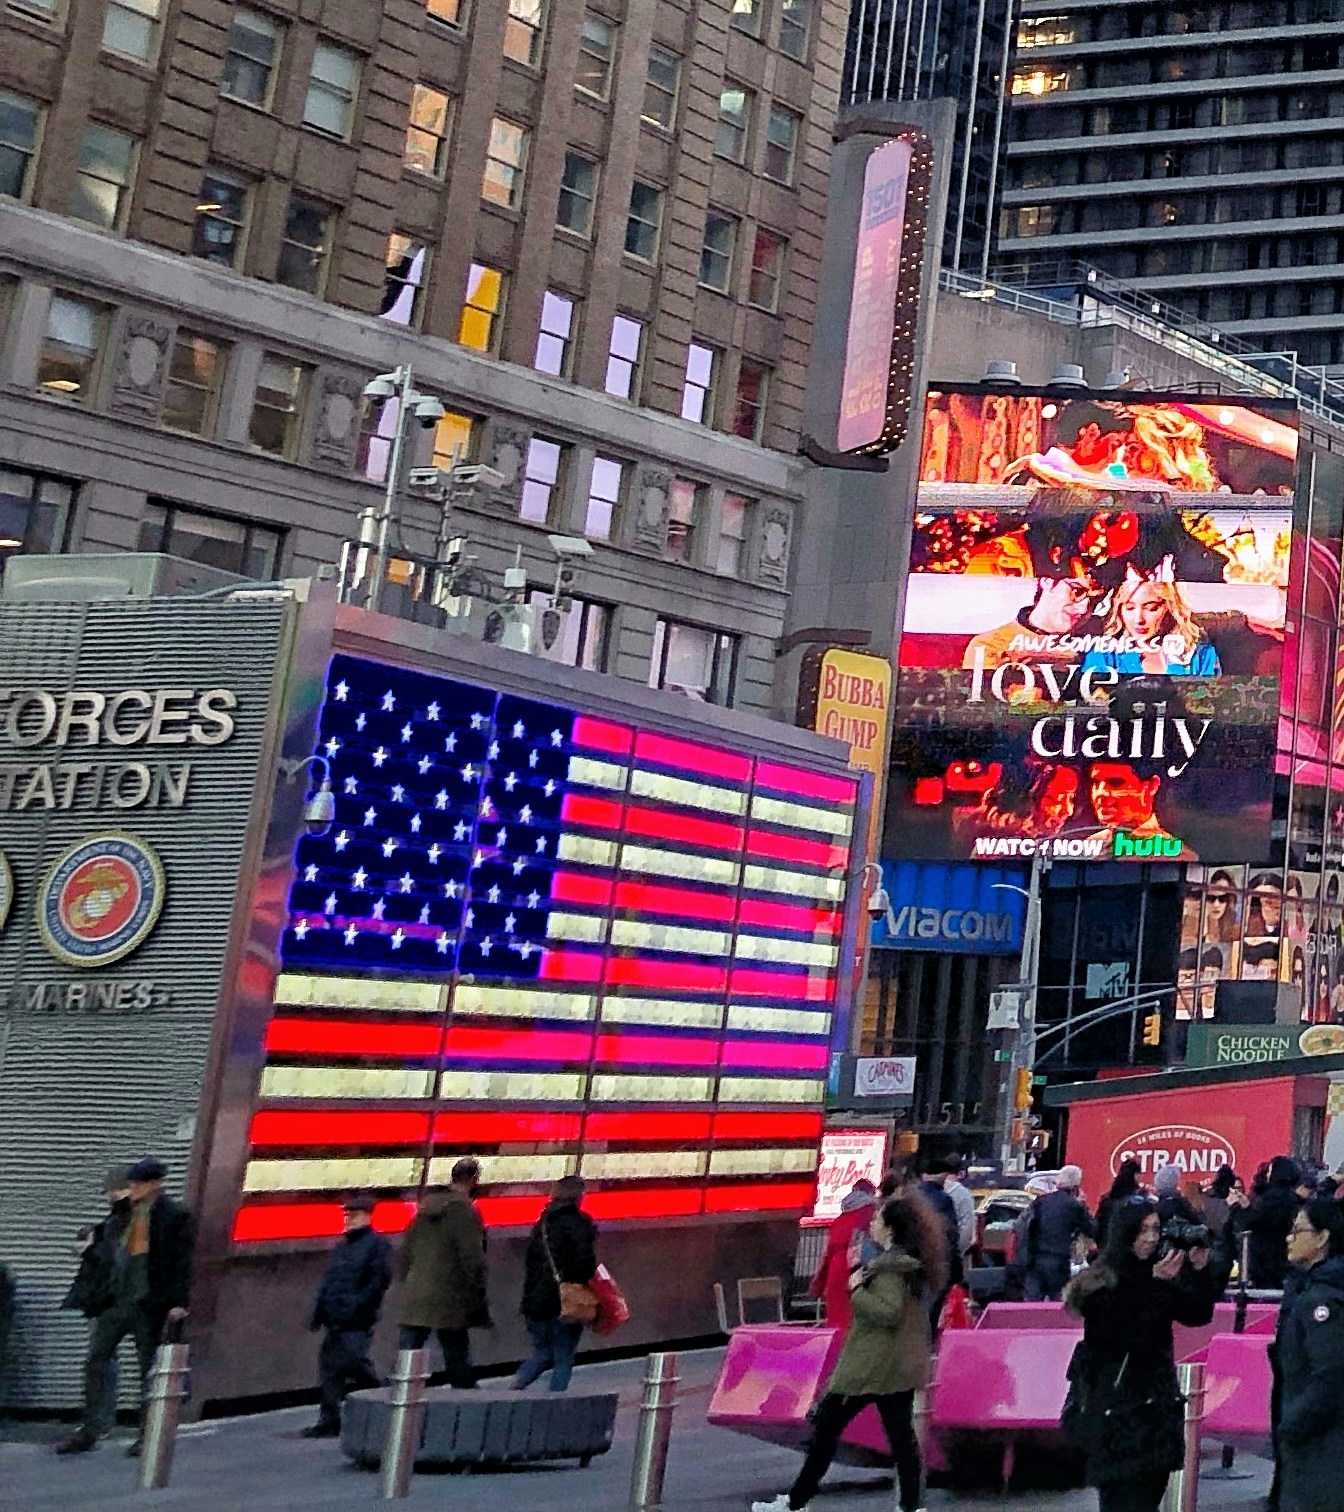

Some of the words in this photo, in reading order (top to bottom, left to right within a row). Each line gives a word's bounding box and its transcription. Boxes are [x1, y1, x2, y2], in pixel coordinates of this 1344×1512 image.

[823, 664, 885, 709] BUBBA
[966, 645, 1119, 707] love
[3, 688, 238, 746] ORCES
[825, 709, 878, 750] GUMP
[1031, 700, 1213, 777] daily
[0, 762, 192, 810] TATION
[1053, 838, 1103, 856] NOW
[1114, 830, 1182, 857] hulu
[26, 983, 154, 1010] MARINES
[1217, 1035, 1290, 1050] CHICKEN
[1217, 1049, 1285, 1062] NOODLE
[924, 1101, 983, 1125] 1515
[1186, 1132, 1211, 1144] BOOKS
